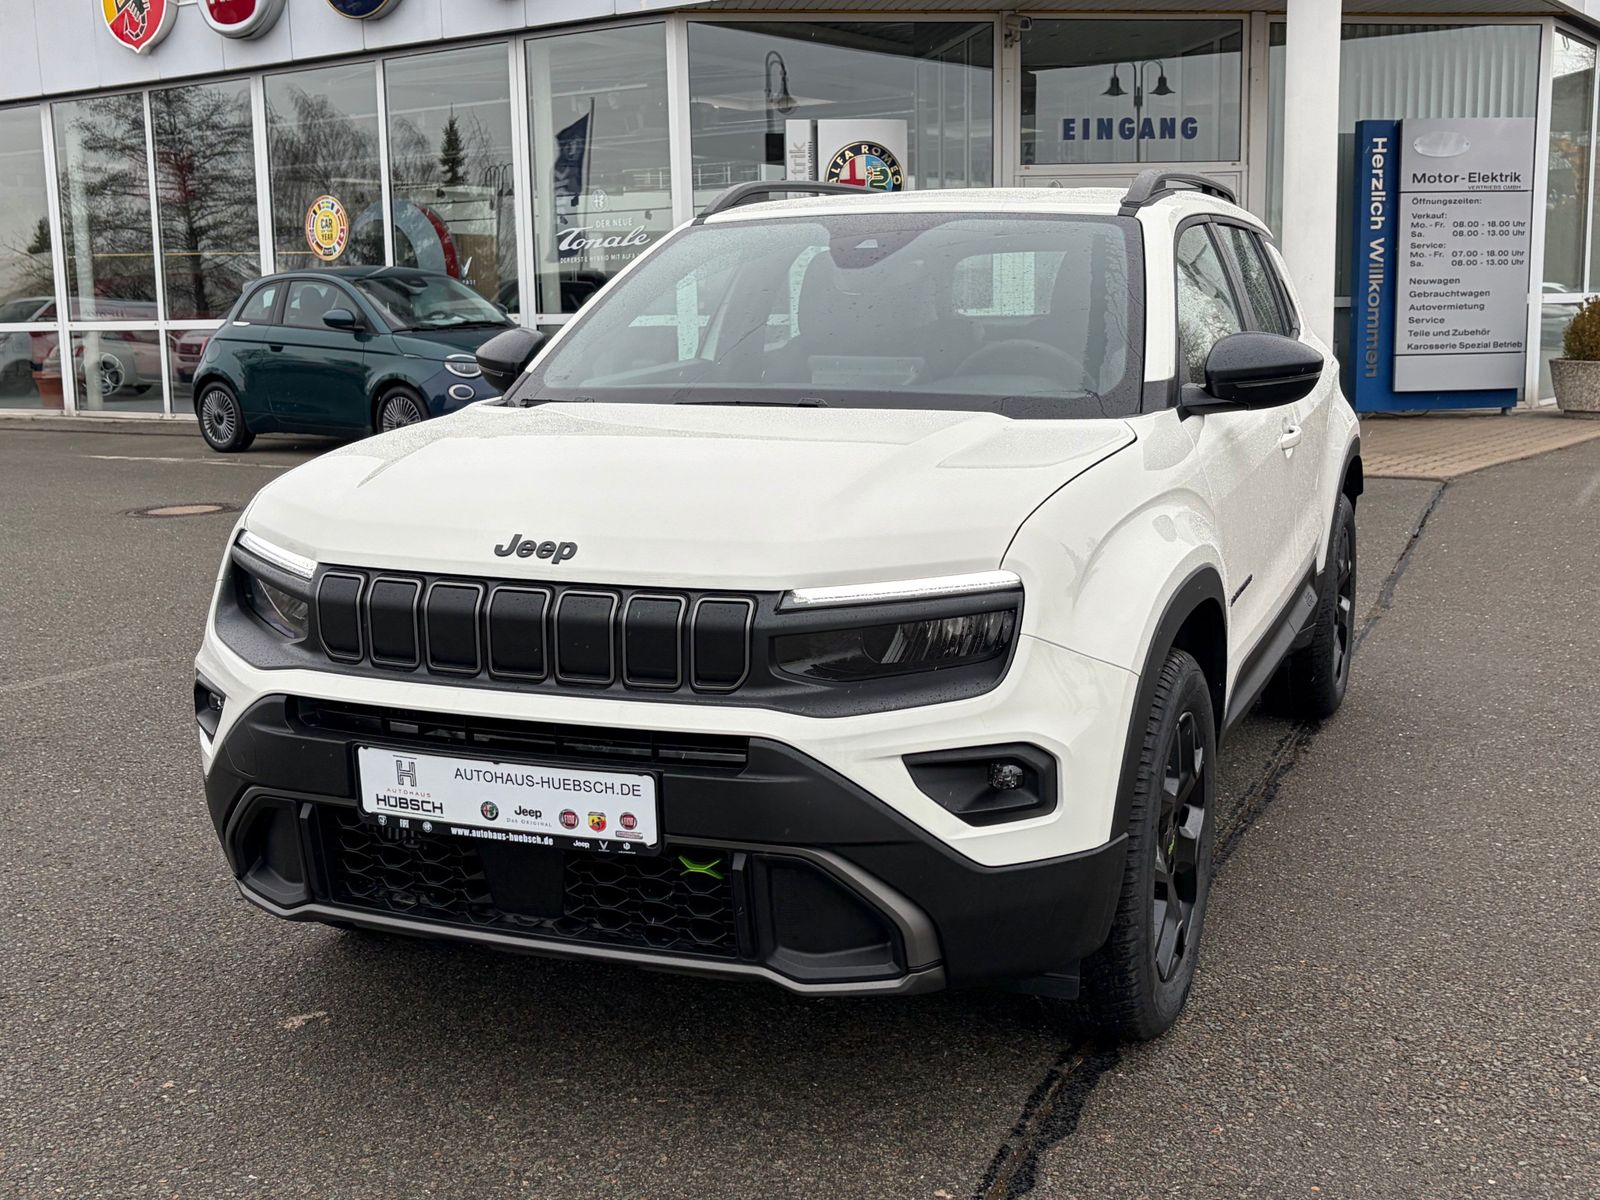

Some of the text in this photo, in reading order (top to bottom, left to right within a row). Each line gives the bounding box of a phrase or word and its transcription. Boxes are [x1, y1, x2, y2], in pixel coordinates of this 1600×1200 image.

[1063, 118, 1198, 140] EINGANG
[861, 144, 901, 184] ROMEO
[1412, 197, 1482, 206] Öffnungszeiten:
[596, 218, 632, 228] DER NEUE
[556, 225, 651, 251] Tonale
[1366, 137, 1388, 378] Herzlich Willkommen
[1409, 290, 1490, 298] Gebrauchtwagen
[1408, 303, 1485, 311] Autovermietung
[1452, 328, 1490, 336] Zubehör
[1459, 342, 1491, 350] Spezial
[494, 534, 578, 564] Jeep
[454, 768, 642, 797] AUTOHAUS-HUEBSCH.DE
[386, 788, 431, 798] AUTOHAUS
[376, 793, 444, 814] HÜBSCH
[514, 805, 542, 820] Jeep
[451, 826, 554, 846] www.autohaus-huebsch.de
[573, 840, 590, 848] Jeep
